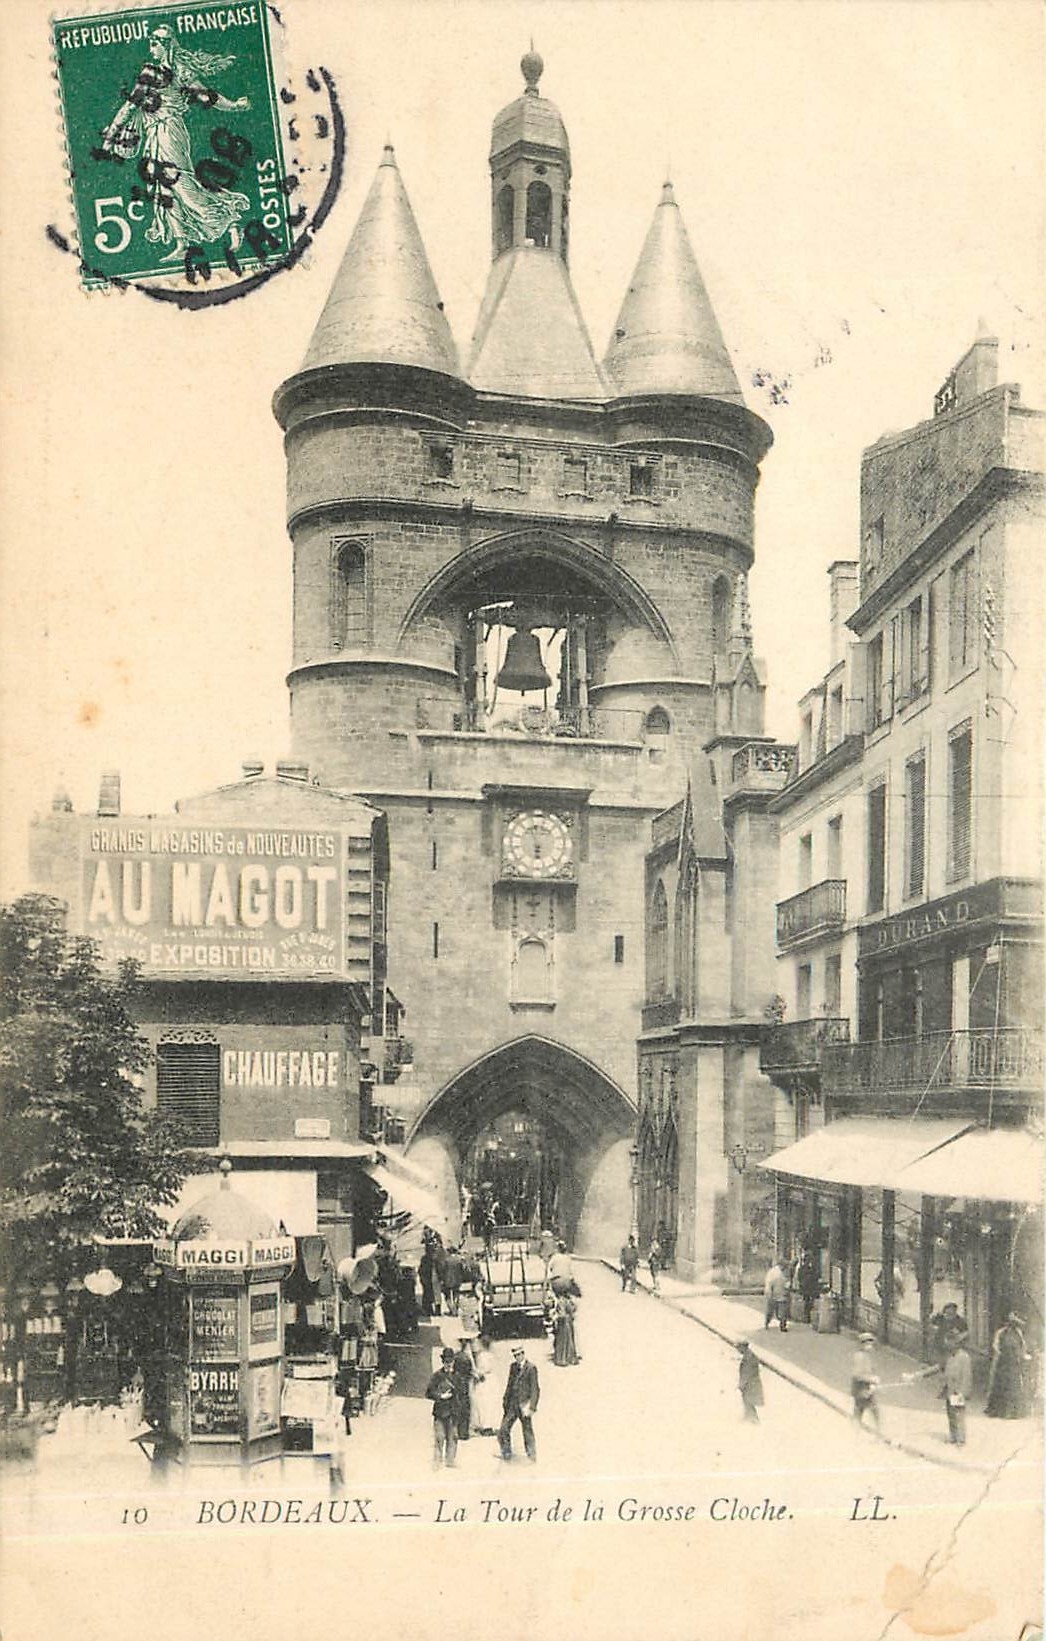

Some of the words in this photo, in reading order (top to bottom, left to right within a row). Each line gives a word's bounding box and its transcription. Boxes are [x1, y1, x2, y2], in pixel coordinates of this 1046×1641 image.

[176, 6, 258, 34] FRANÇAISE
[91, 829, 144, 854] GRANDS
[149, 829, 223, 856] MAGASINS
[226, 836, 245, 856] de
[88, 860, 152, 926] AU
[172, 862, 338, 931] MAGOT
[878, 901, 970, 947] DURAND
[150, 943, 276, 967] EXPOSITION
[223, 1050, 339, 1086] CHAUFFAGE
[182, 1249, 244, 1264] MAGGI
[254, 1245, 294, 1263] MAGGI
[196, 1325, 235, 1337] MENIER
[190, 1371, 239, 1391] BYRRH
